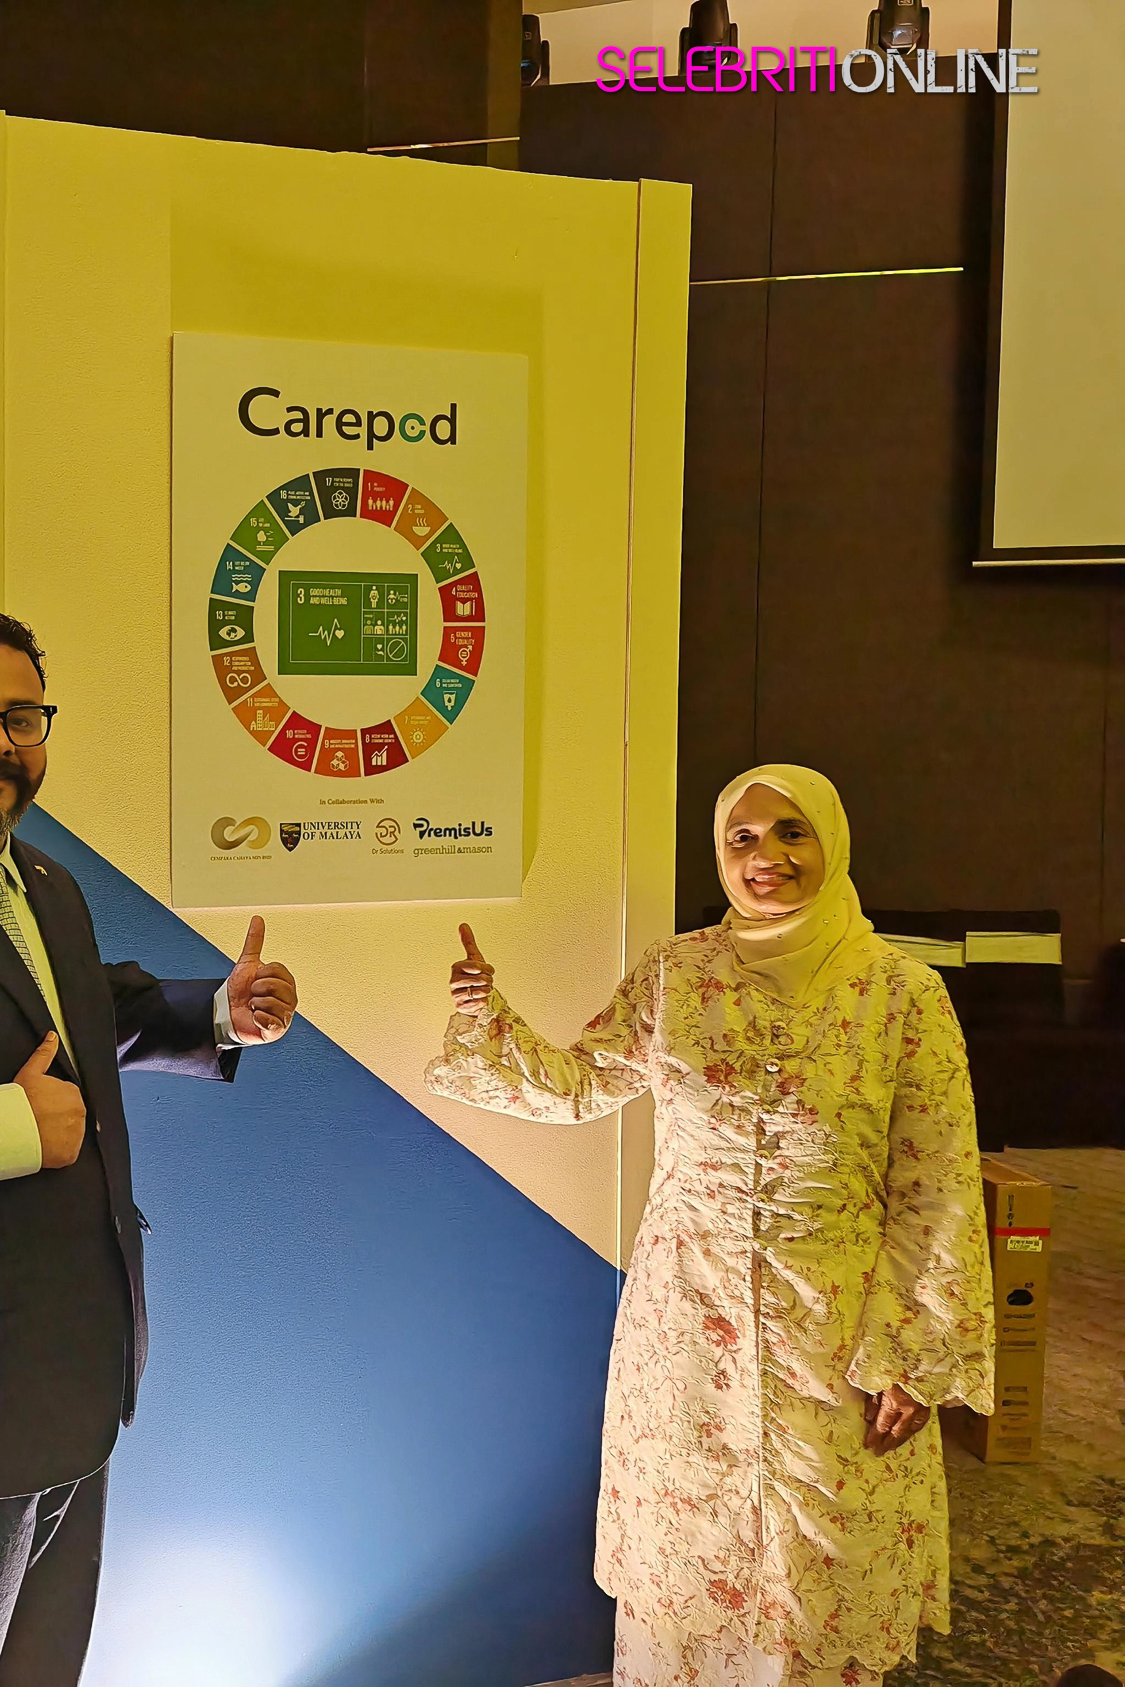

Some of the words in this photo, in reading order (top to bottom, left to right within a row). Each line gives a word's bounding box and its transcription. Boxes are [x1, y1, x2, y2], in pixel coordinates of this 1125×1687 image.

[326, 478, 332, 486] 17
[280, 490, 287, 499] 16
[408, 504, 412, 514] 2
[250, 518, 258, 527] 15
[436, 544, 440, 552] 3
[226, 561, 232, 570] 14
[451, 586, 456, 596] 4
[297, 588, 304, 604] 3
[310, 588, 323, 596] GOOD
[324, 588, 342, 596] HEALTH
[310, 596, 320, 604] AND
[216, 610, 223, 620] 13
[450, 634, 455, 642] 5
[223, 656, 230, 666] 12
[435, 679, 440, 687] 6
[247, 698, 253, 707] 11
[286, 730, 293, 738] 10
[365, 734, 370, 743] 8
[325, 740, 330, 748] 9
[303, 821, 362, 830] UNIVERSITY
[413, 817, 493, 840] PremisUs
[303, 832, 316, 840] OF
[319, 831, 361, 840] MALAYA
[413, 845, 456, 857] greenhill
